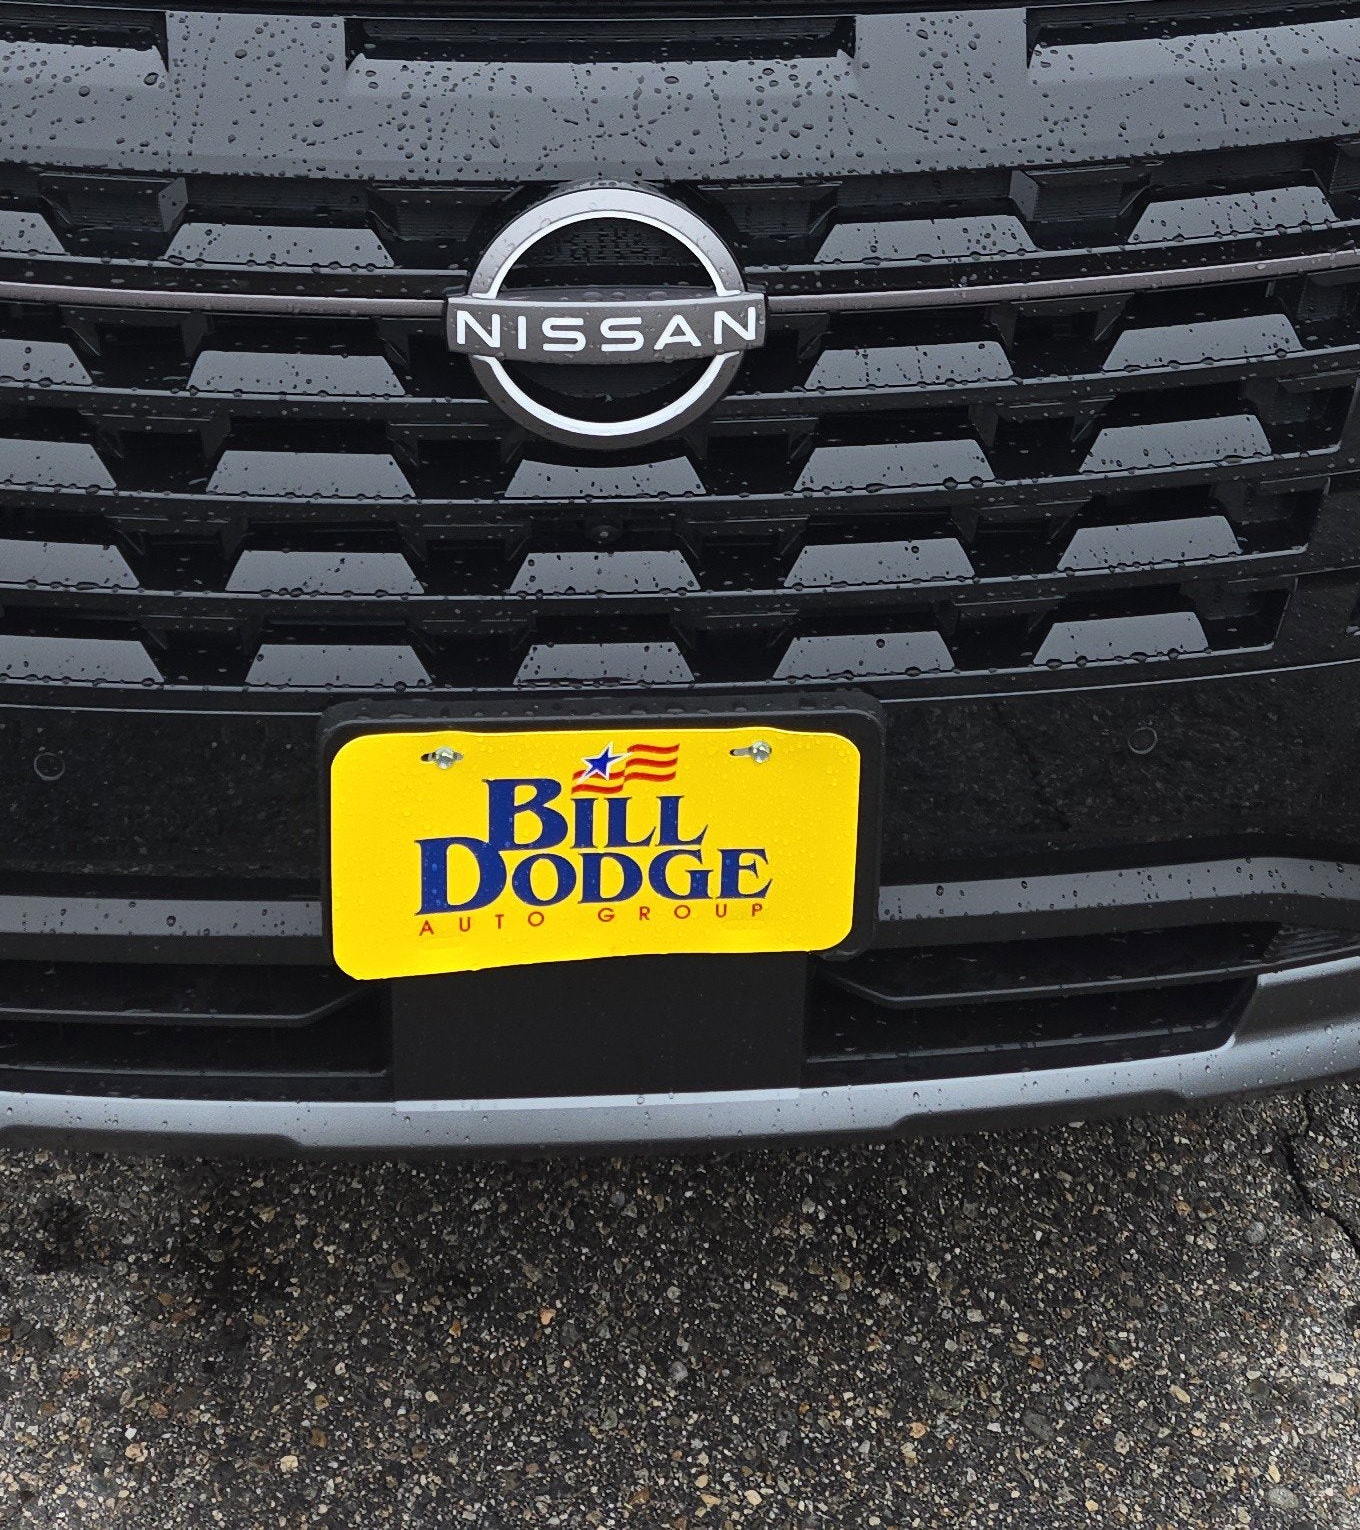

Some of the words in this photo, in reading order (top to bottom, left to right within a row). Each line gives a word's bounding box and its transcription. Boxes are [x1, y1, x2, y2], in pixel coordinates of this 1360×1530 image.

[456, 307, 757, 352] NISSAN
[482, 778, 708, 851] BILL
[414, 836, 773, 916] DODGE
[418, 911, 545, 937] AUTO
[597, 902, 764, 923] GROUP
